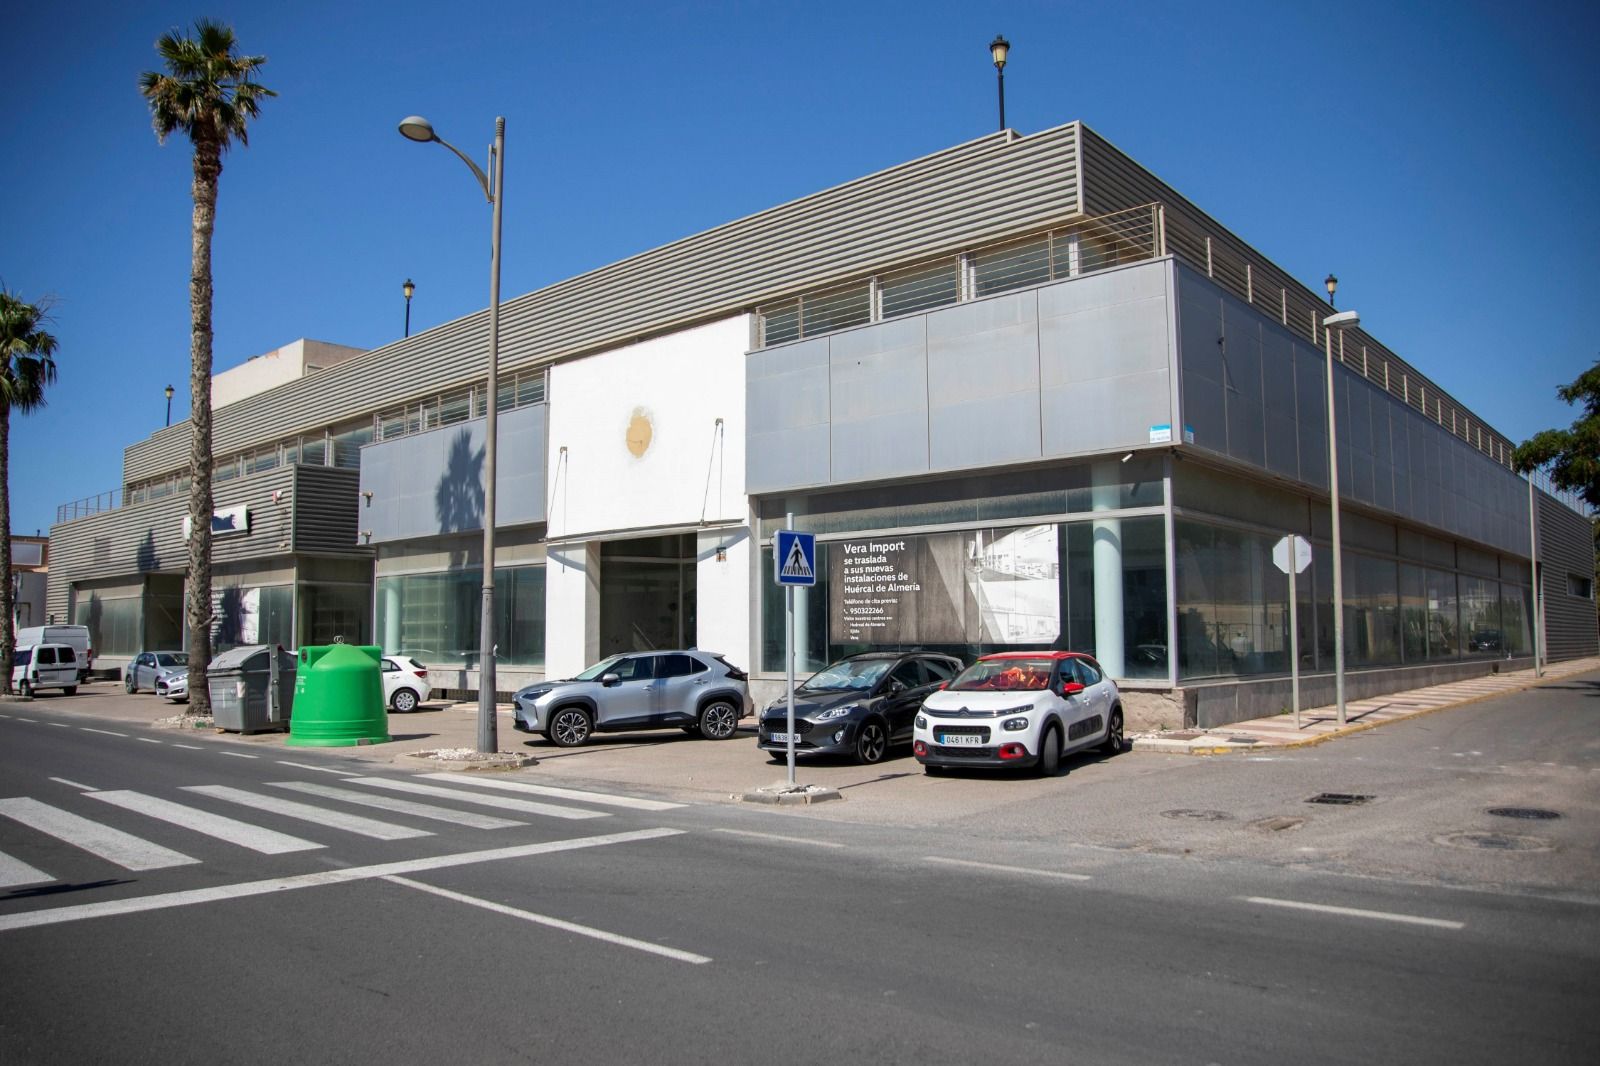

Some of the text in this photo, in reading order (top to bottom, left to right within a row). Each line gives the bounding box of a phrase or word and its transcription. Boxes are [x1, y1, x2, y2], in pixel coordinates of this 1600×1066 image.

[844, 541, 905, 554] Vera Import
[854, 555, 887, 564] traslada
[865, 565, 894, 573] nuevas
[844, 572, 908, 583] instalaciones de
[844, 582, 920, 593] Huércal de Almería
[946, 736, 979, 744] 0461 KFR
